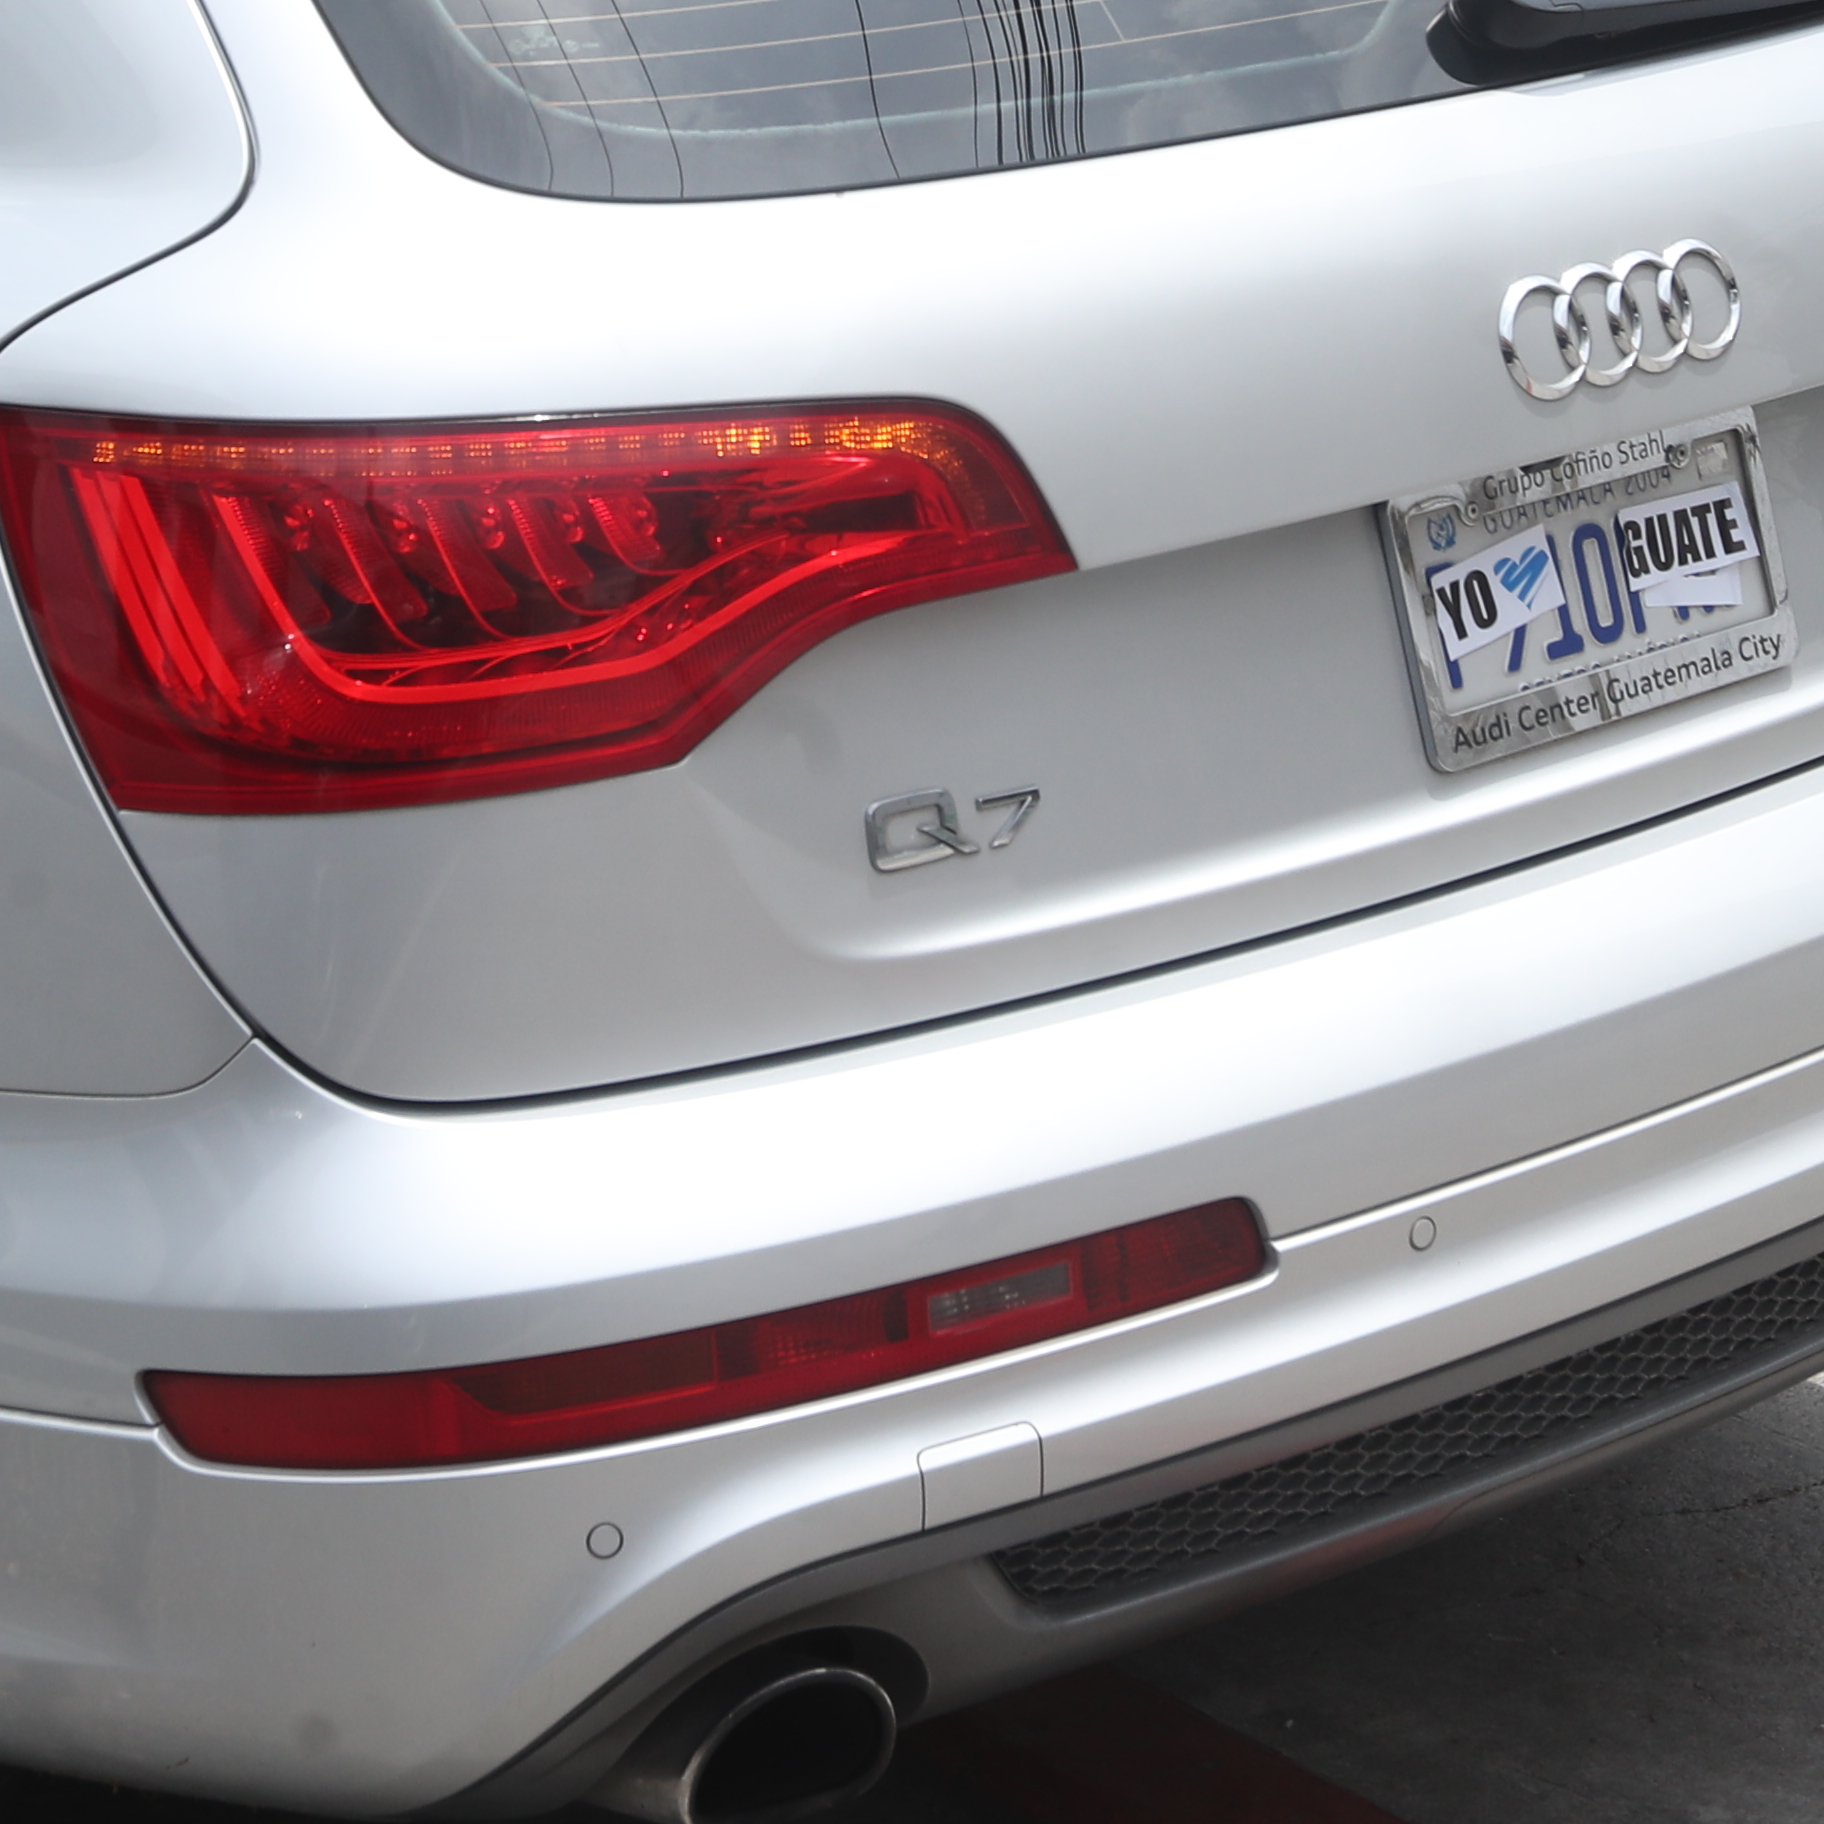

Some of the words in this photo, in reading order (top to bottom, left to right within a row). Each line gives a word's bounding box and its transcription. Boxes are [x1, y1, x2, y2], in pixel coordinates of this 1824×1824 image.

[1483, 469, 1545, 501] Grupo
[1617, 429, 1667, 465] Stahl
[1436, 569, 1498, 642] YO
[1623, 498, 1746, 579] GUATE
[1453, 716, 1512, 753] Audi
[1517, 690, 1600, 731] Center
[1606, 647, 1734, 704] Guatemala
[1738, 632, 1783, 663] City
[865, 785, 1041, 874] Q7
